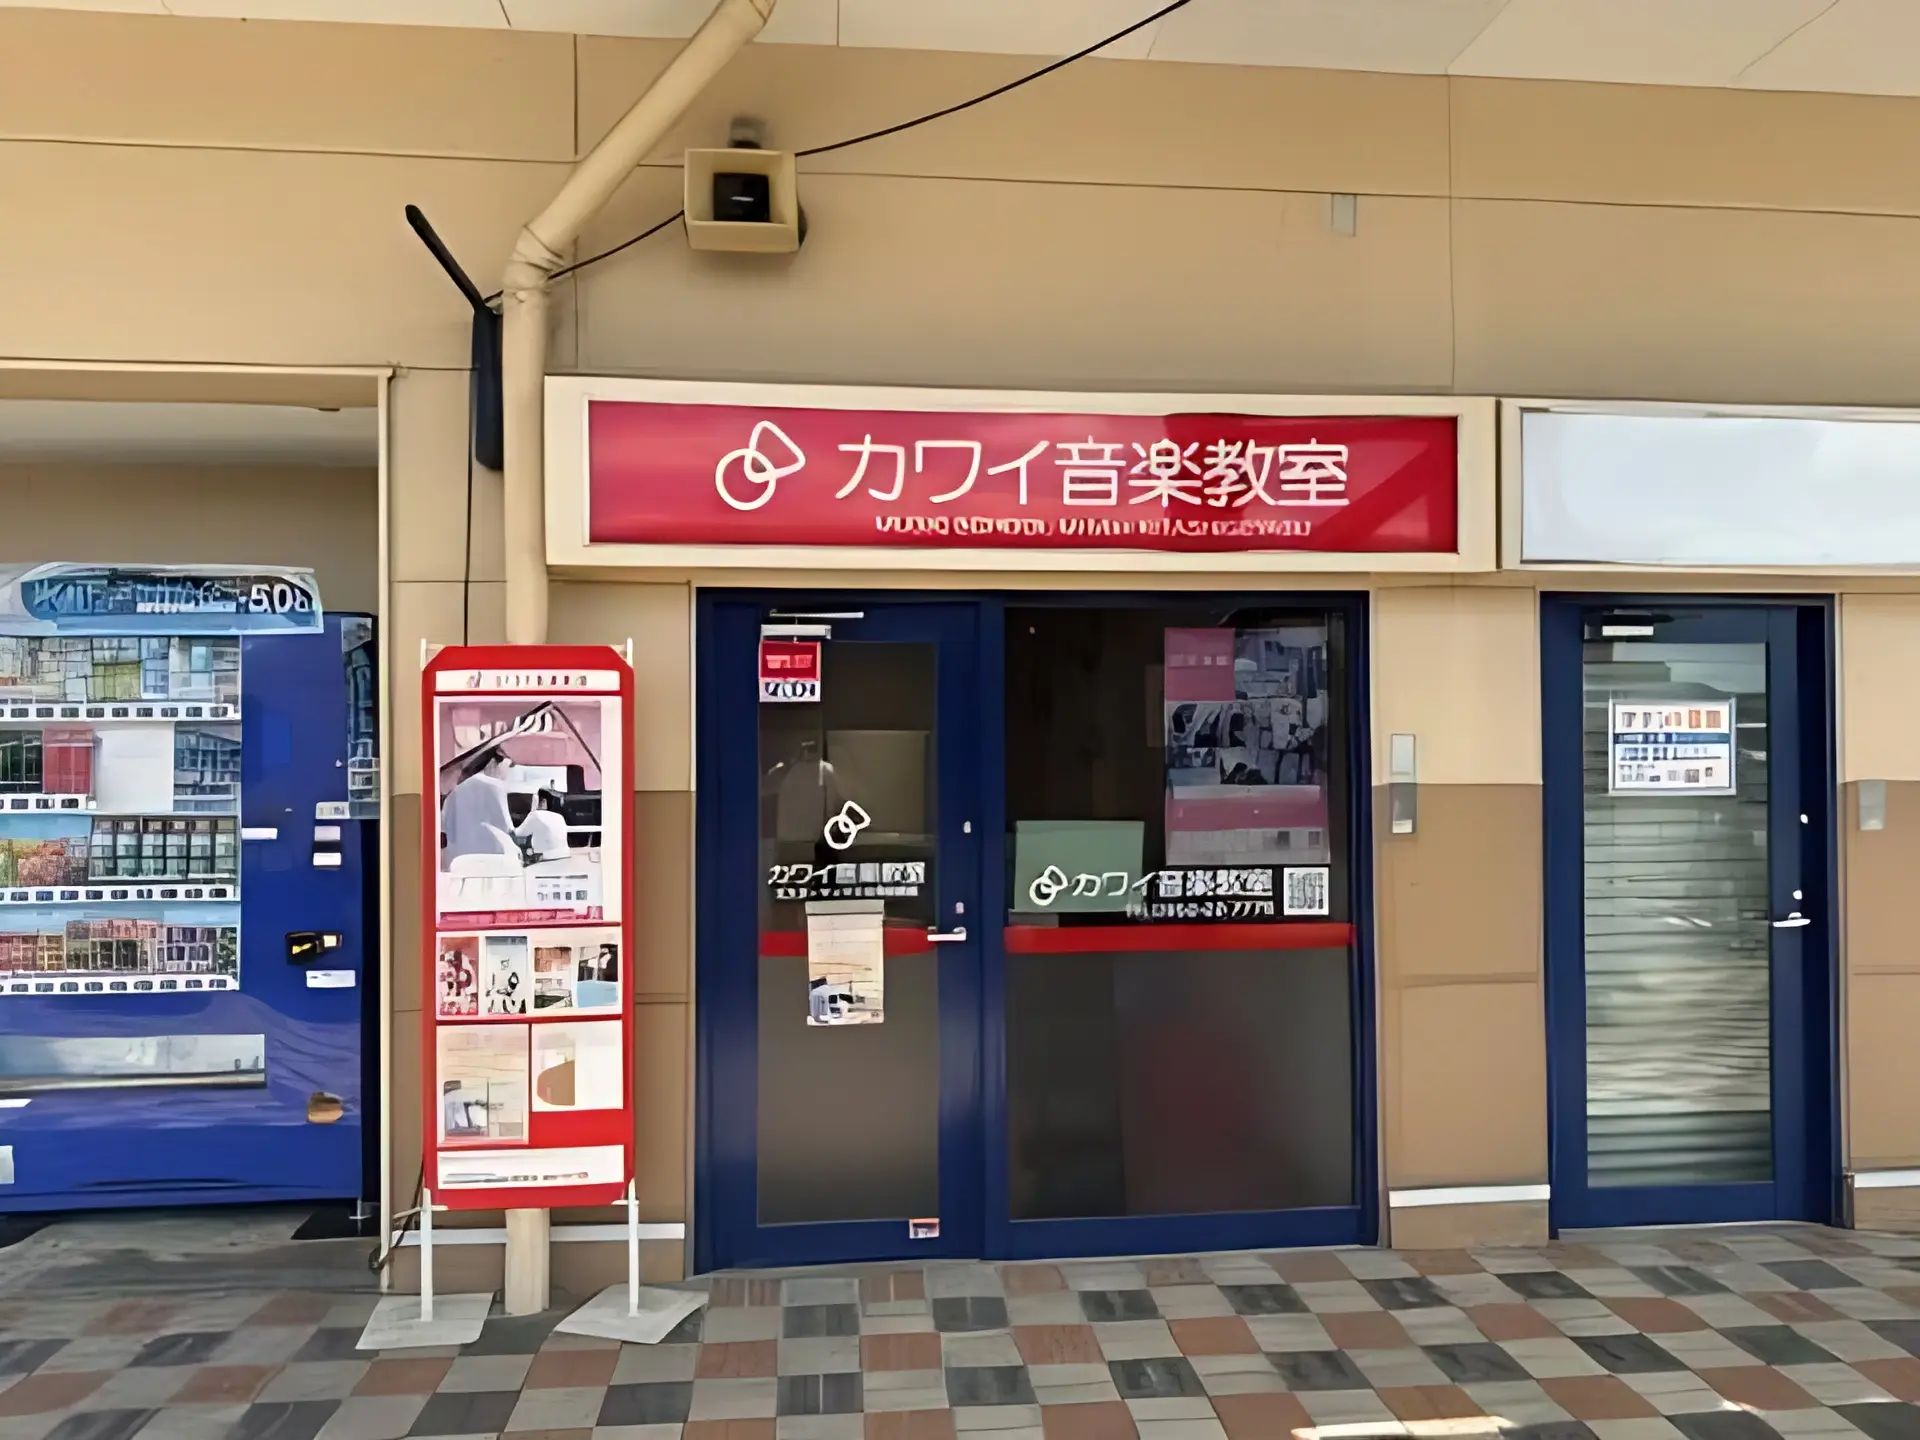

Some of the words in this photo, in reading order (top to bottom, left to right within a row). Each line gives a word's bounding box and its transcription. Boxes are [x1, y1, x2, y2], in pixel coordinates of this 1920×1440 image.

[835, 434, 1350, 507] カワイ音楽教室
